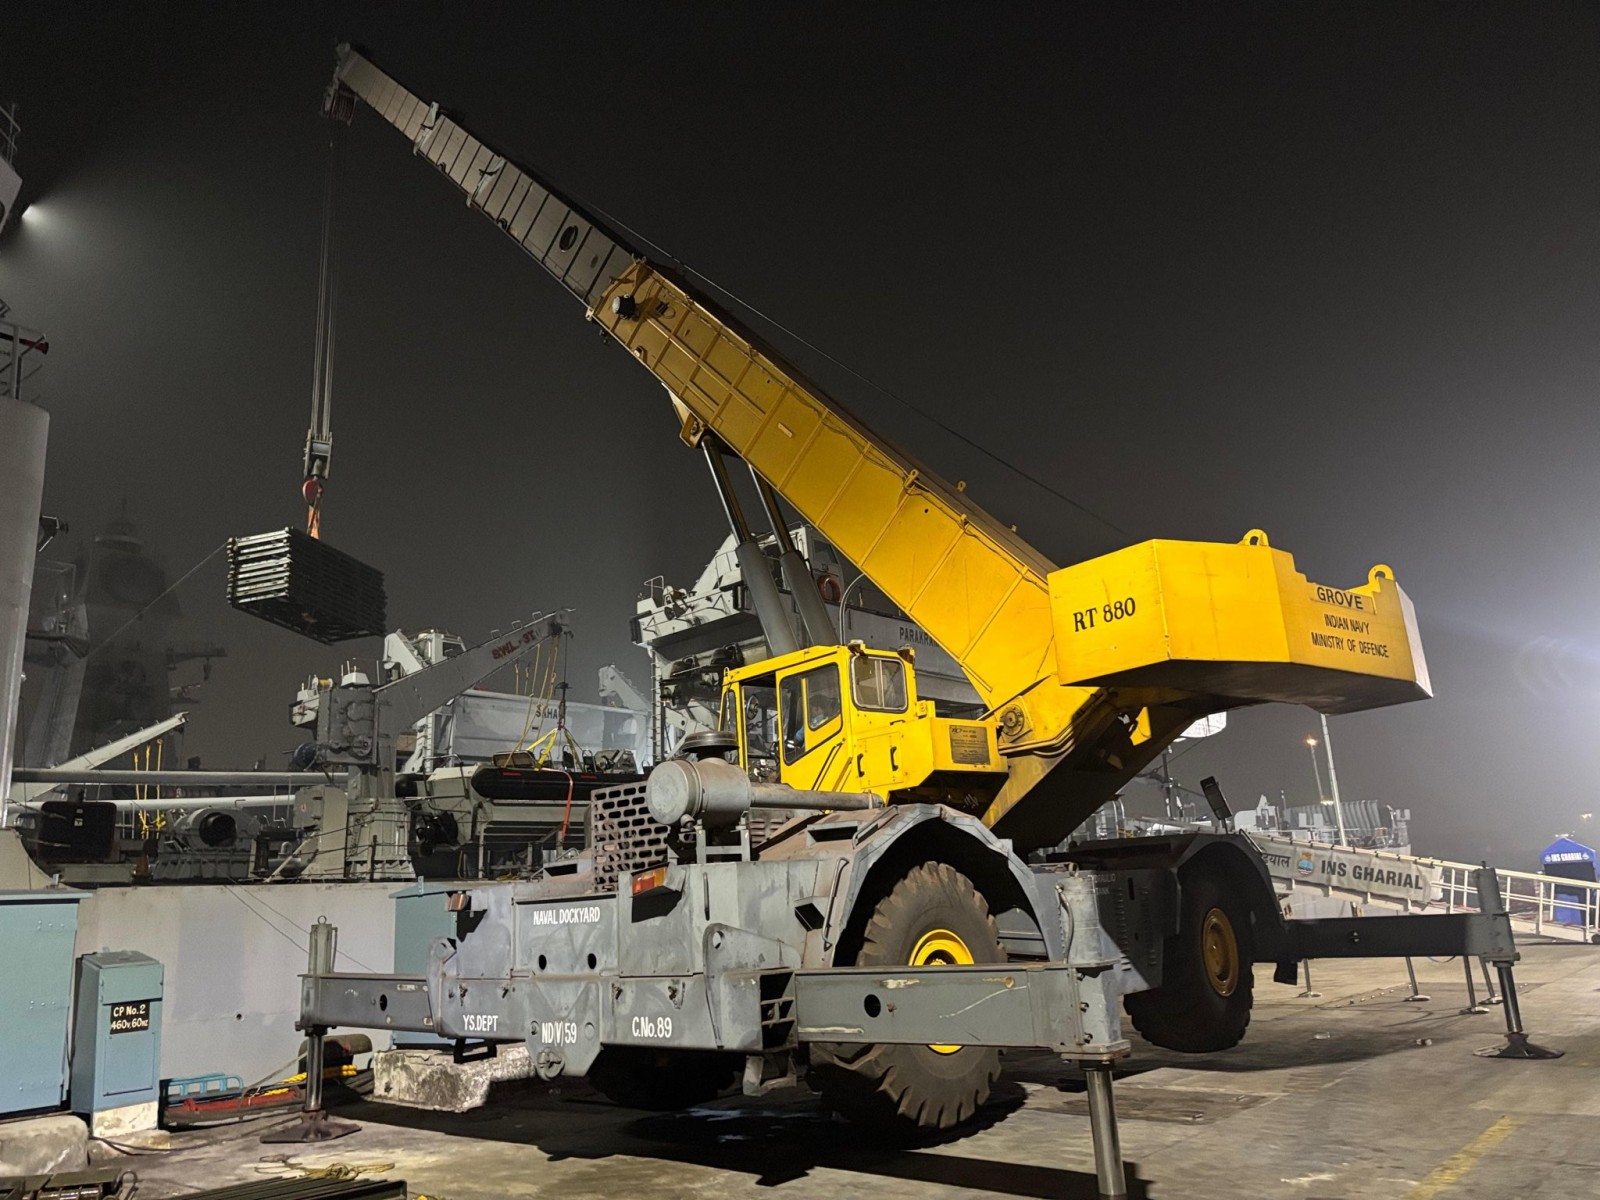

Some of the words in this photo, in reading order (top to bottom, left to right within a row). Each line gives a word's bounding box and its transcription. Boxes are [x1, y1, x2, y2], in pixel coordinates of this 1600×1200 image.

[1317, 587, 1364, 610] GROVE
[1073, 607, 1098, 632] RT
[1103, 597, 1136, 623] 880
[1324, 614, 1350, 631] INDIAN
[1349, 619, 1370, 635] NAVY
[1311, 632, 1345, 650] MINISTRY
[1347, 638, 1357, 653] OF
[1359, 641, 1389, 658] DEFENCE
[1321, 860, 1347, 878] INS
[1352, 866, 1424, 890] GHARIAL
[533, 910, 558, 926] NAVAL
[559, 906, 601, 924] DOCKYARD
[113, 1006, 125, 1017] CP
[462, 1014, 499, 1032] YS.DEPT
